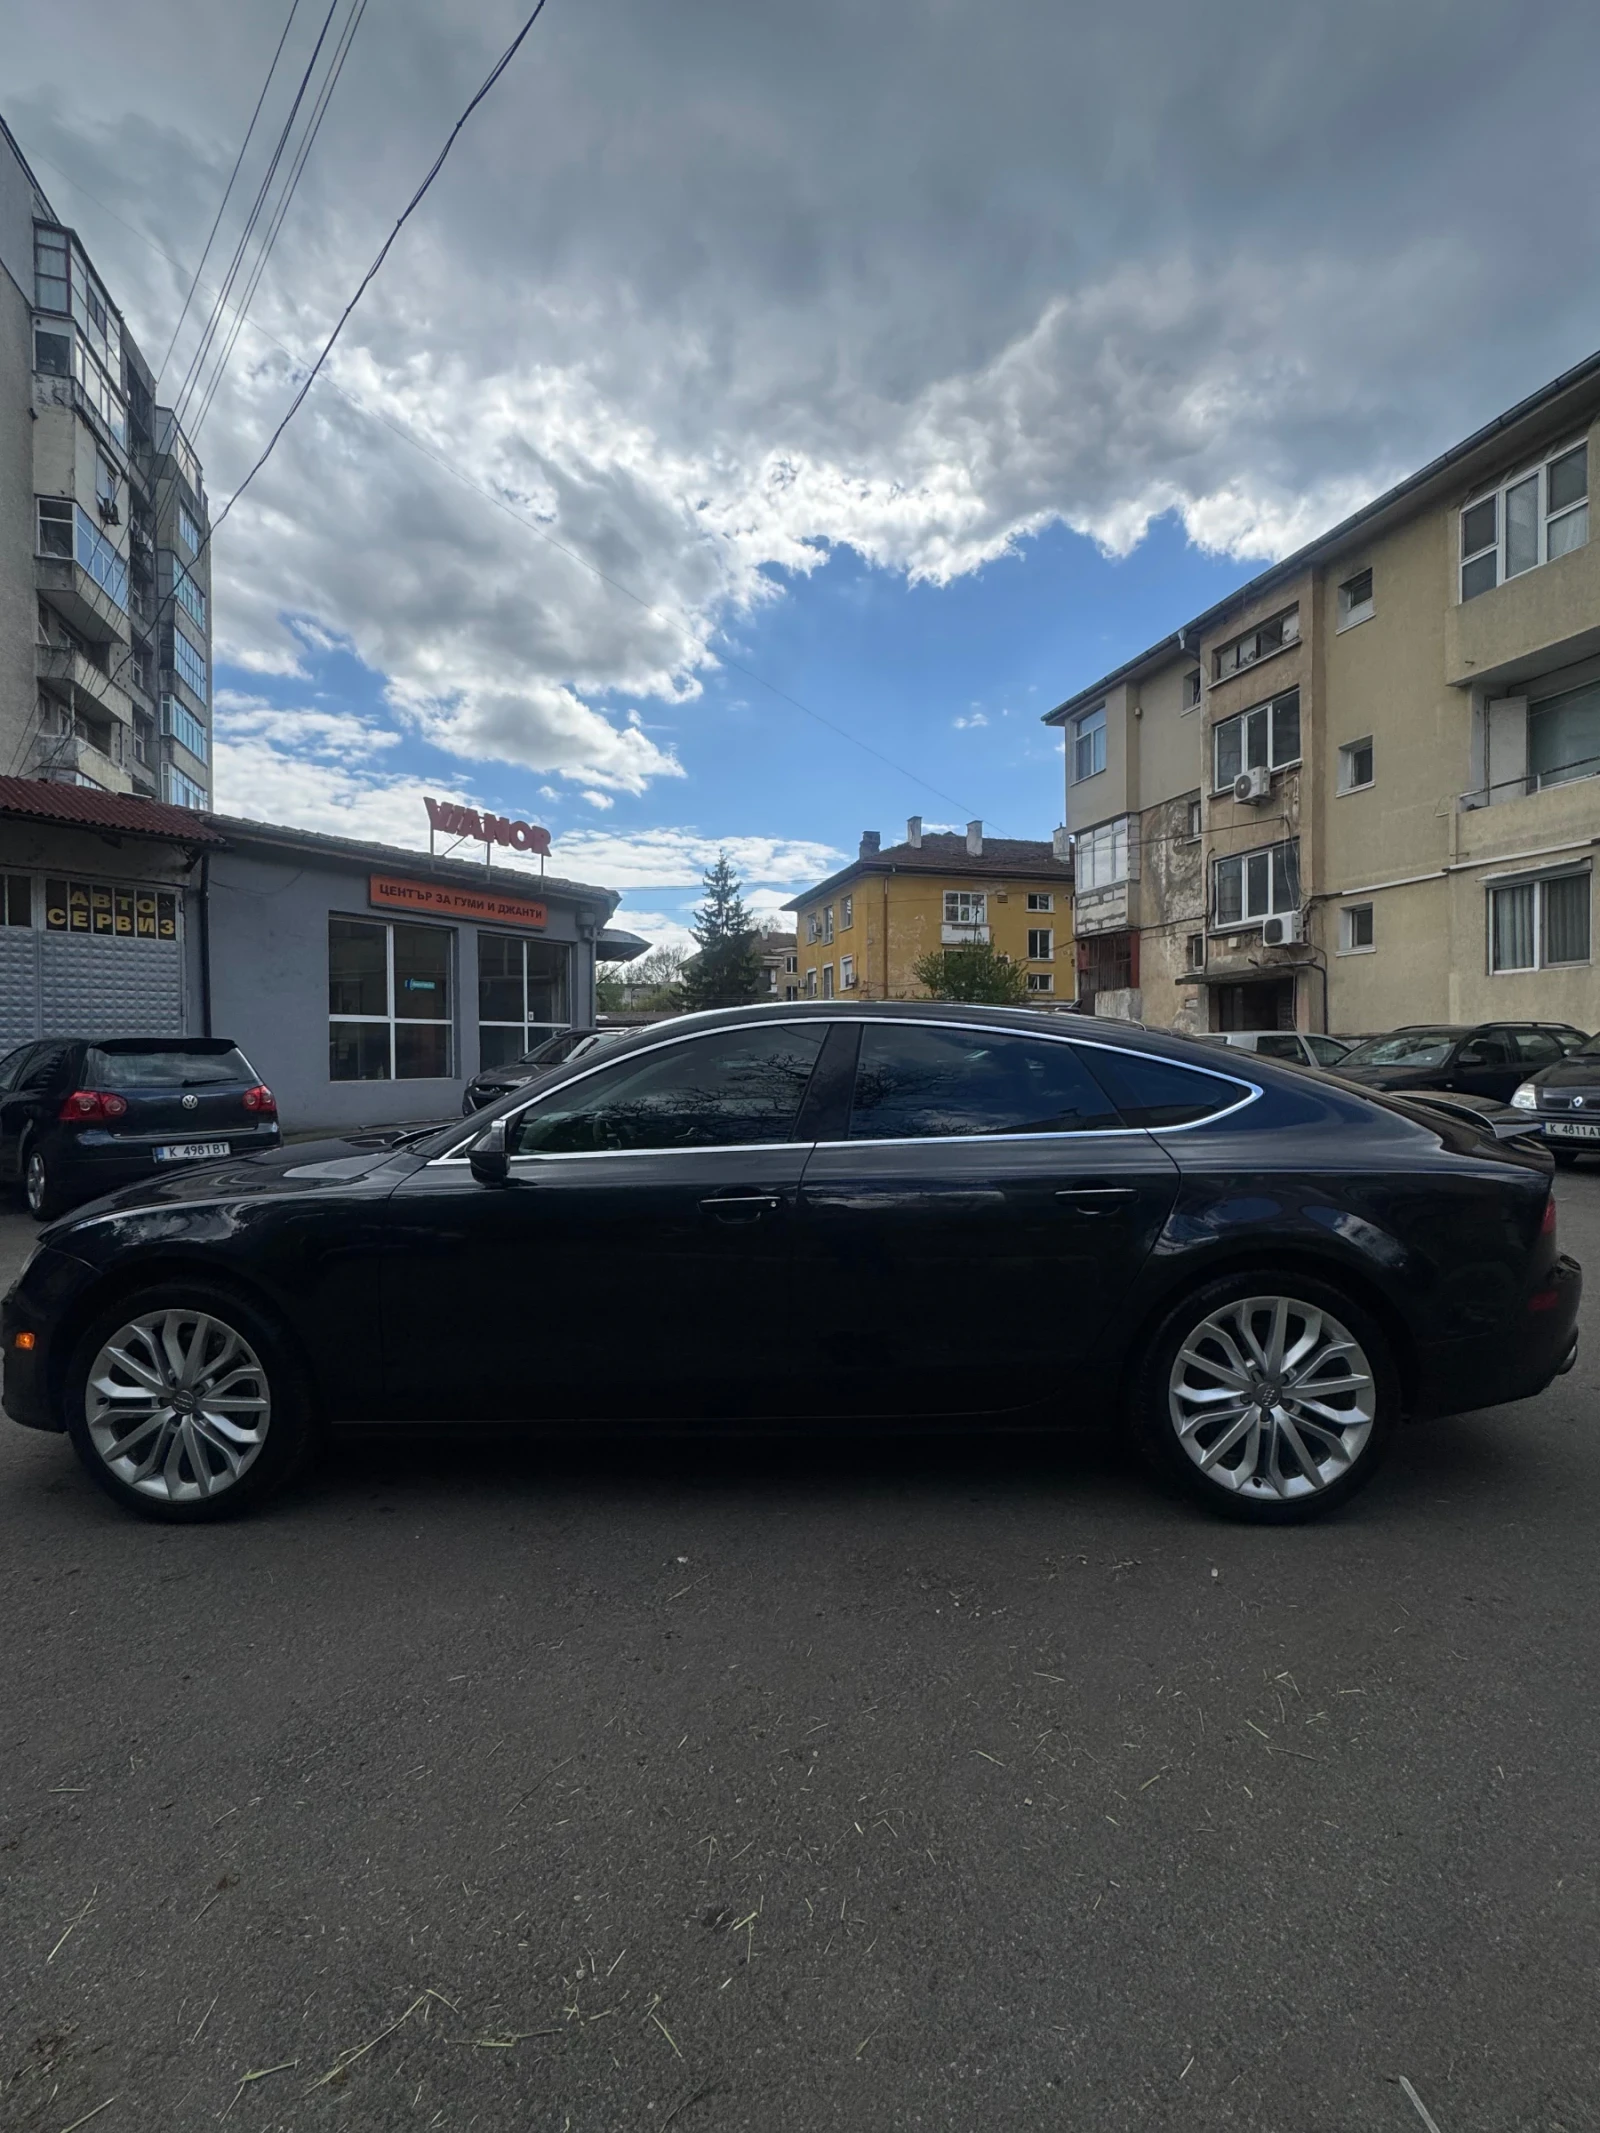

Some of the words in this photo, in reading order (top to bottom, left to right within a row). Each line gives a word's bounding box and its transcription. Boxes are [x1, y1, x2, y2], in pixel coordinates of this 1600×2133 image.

[423, 796, 552, 857] VIANOR
[70, 891, 156, 913] АВТО
[379, 884, 432, 901] ЦЕНТЪР
[435, 893, 451, 905] ЗА
[454, 897, 484, 910] ГУМИ
[487, 902, 495, 912] И
[498, 903, 542, 919] ДЖАНТИ
[47, 908, 175, 935] СЕРВИЗ
[1550, 1124, 1557, 1133] K
[169, 1146, 177, 1157] K
[183, 1143, 227, 1156] 4981BT
